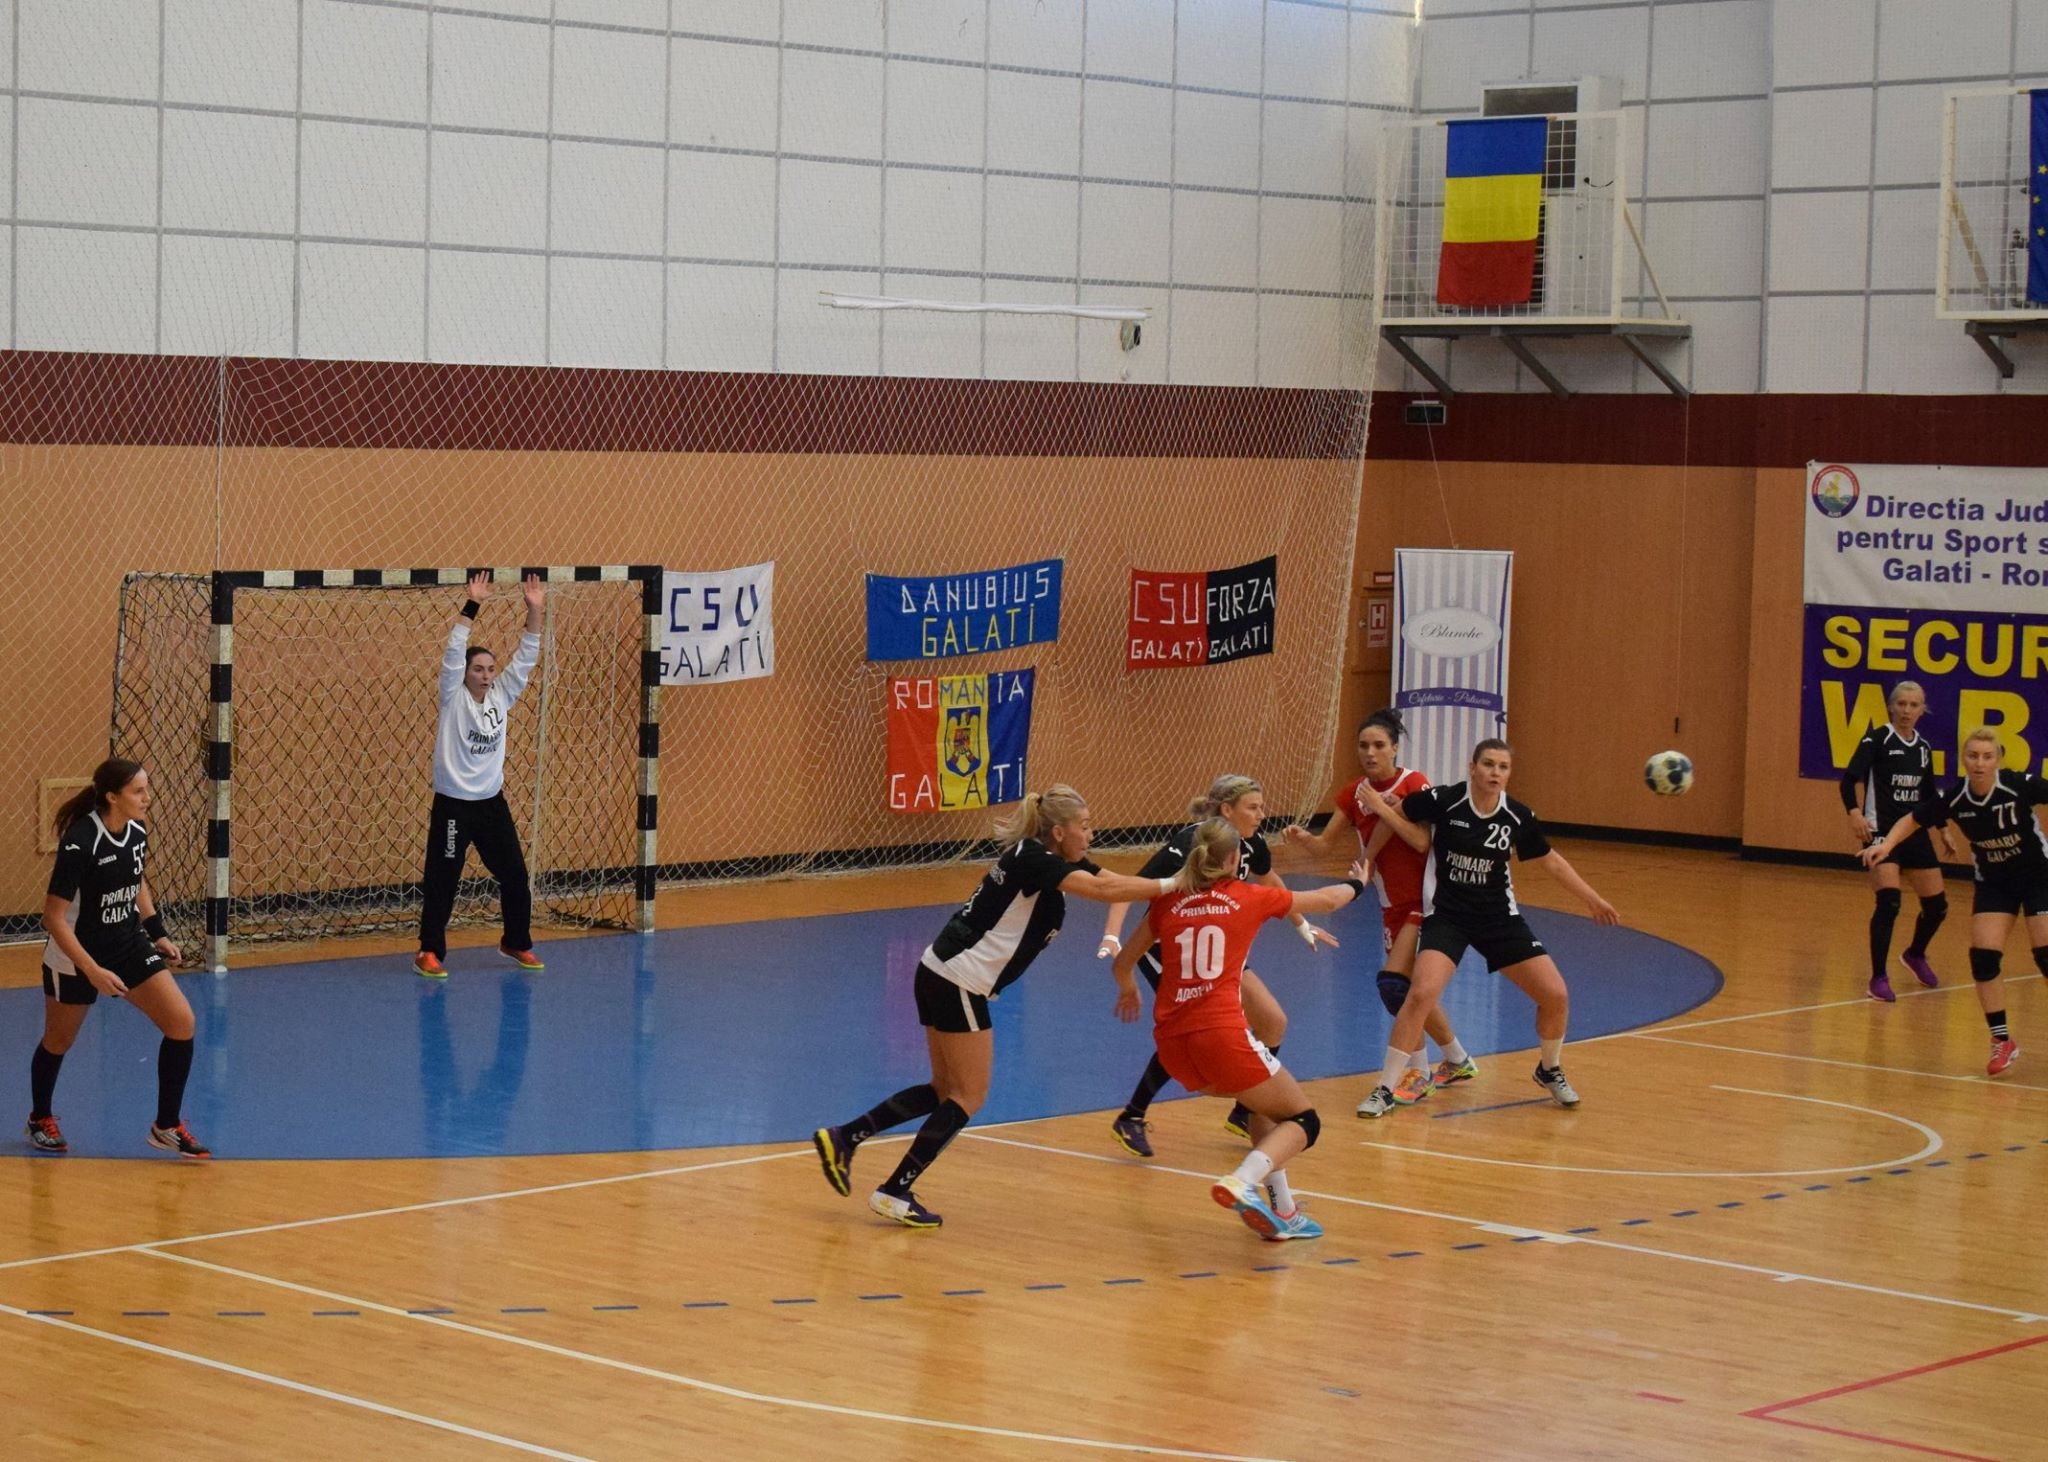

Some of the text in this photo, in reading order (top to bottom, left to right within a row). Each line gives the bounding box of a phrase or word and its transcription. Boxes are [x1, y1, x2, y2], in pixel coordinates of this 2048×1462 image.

[1866, 495, 1984, 521] Directia
[1837, 529, 1933, 552] pentru
[1944, 528, 2027, 557] Sport
[1883, 558, 1972, 584] Galati
[2002, 562, 2048, 587] Ro
[670, 584, 758, 633] CSU
[1134, 577, 1276, 625] CSU FORZA
[484, 707, 503, 729] 12
[1992, 802, 2018, 829] 77
[445, 819, 458, 858] Kempa
[1484, 823, 1511, 850] 28
[1174, 925, 1226, 980] 10
